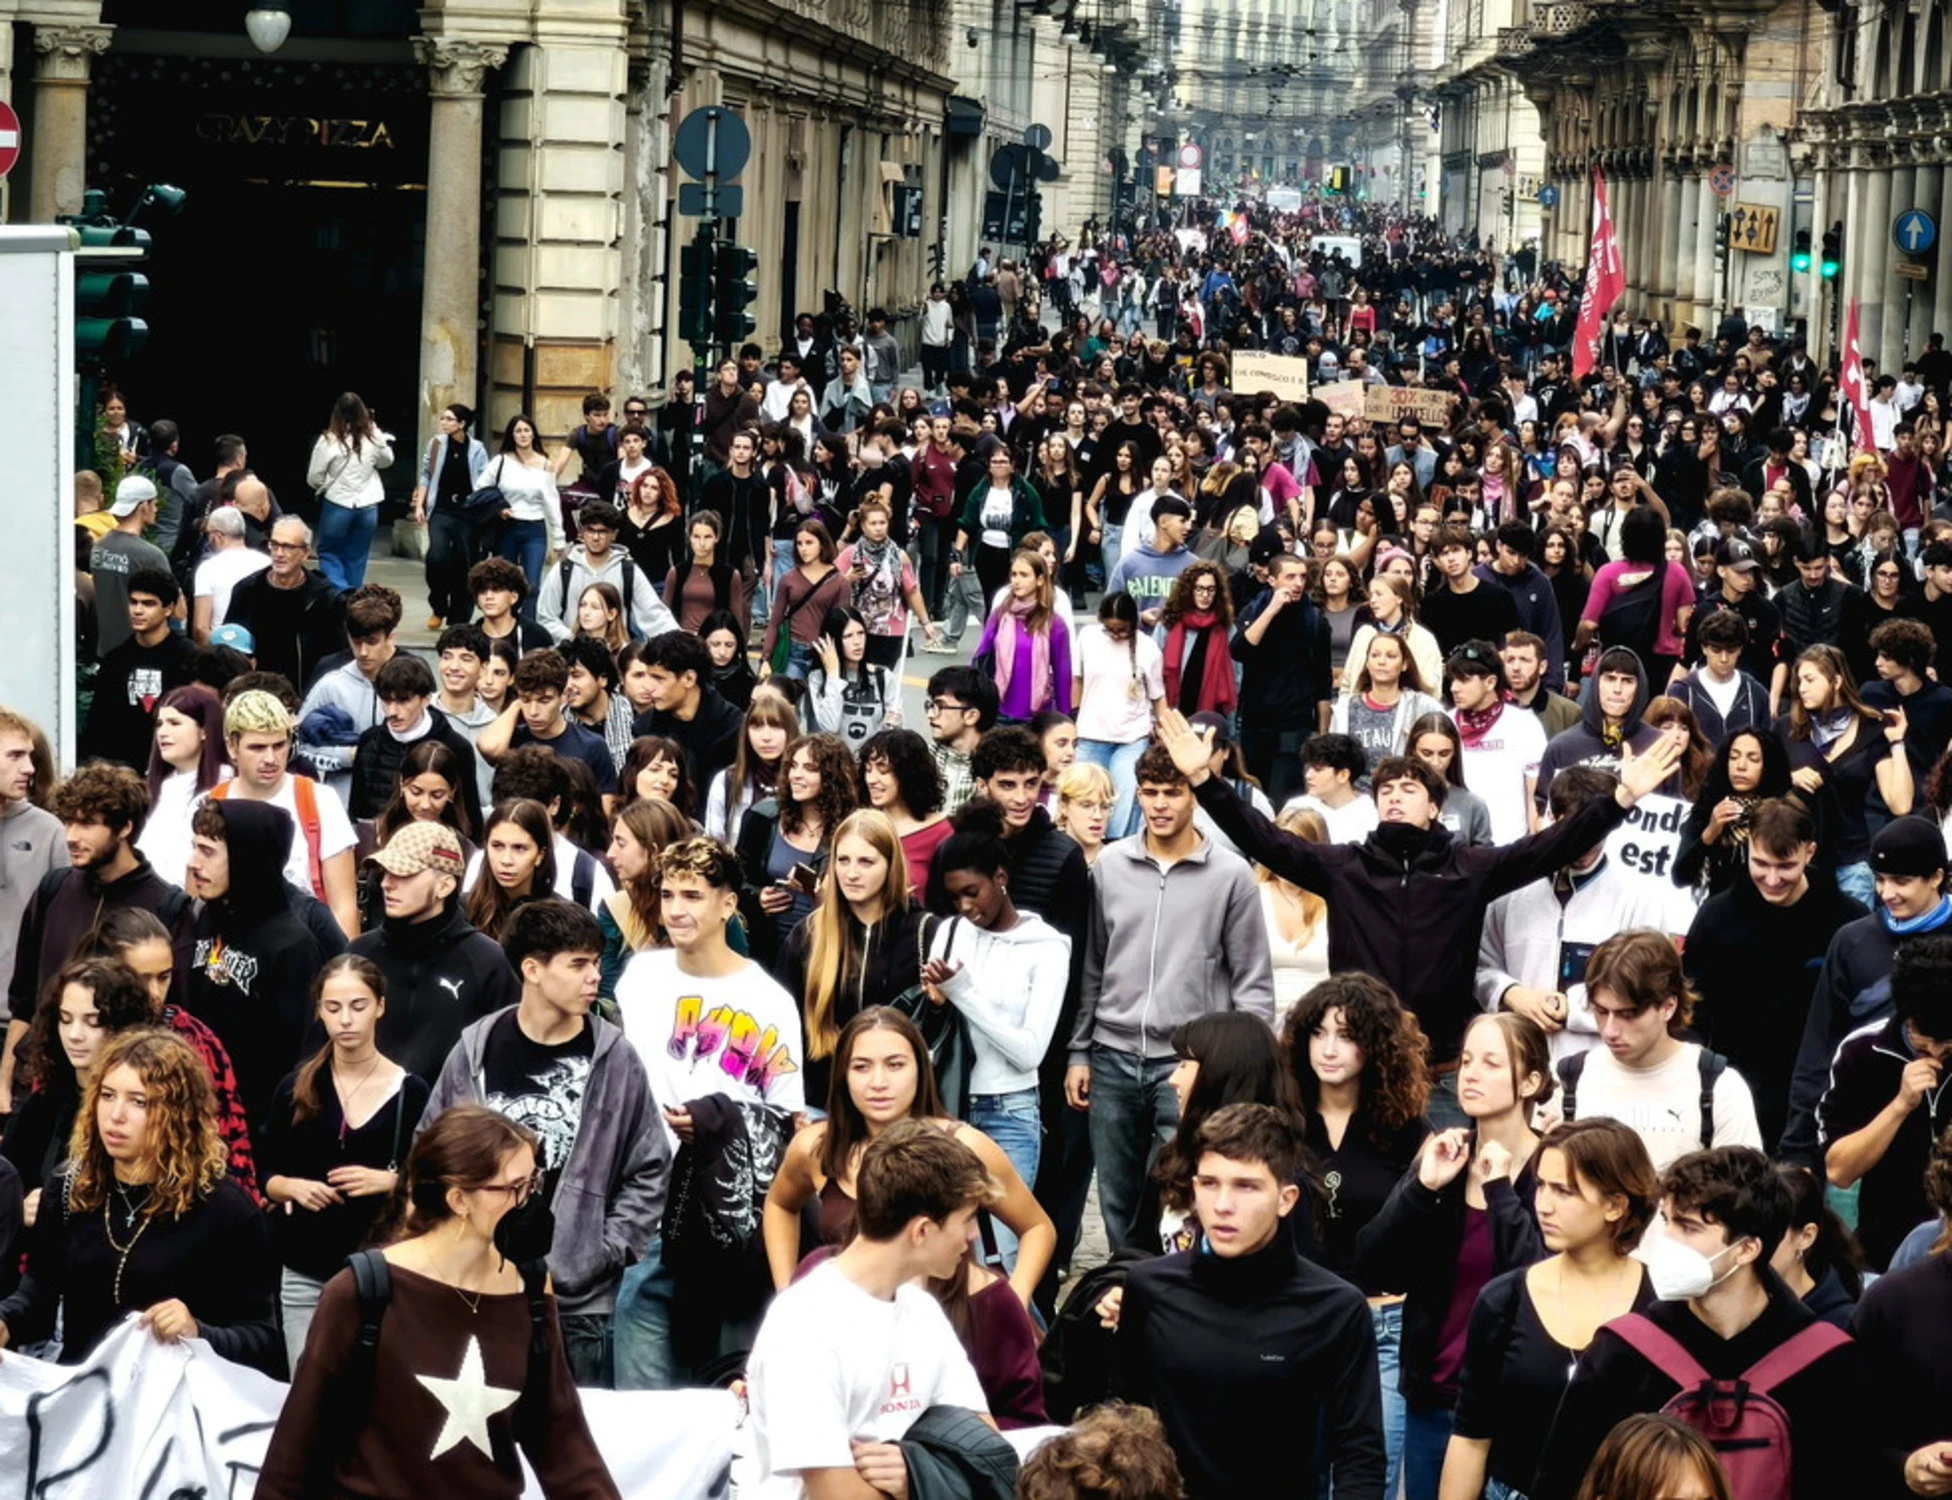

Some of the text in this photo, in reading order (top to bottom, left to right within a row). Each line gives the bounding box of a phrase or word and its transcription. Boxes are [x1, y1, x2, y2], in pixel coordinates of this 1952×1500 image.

[302, 116, 396, 149] PIZZA
[1388, 389, 1417, 405] 30%
[1620, 841, 1672, 877] est
